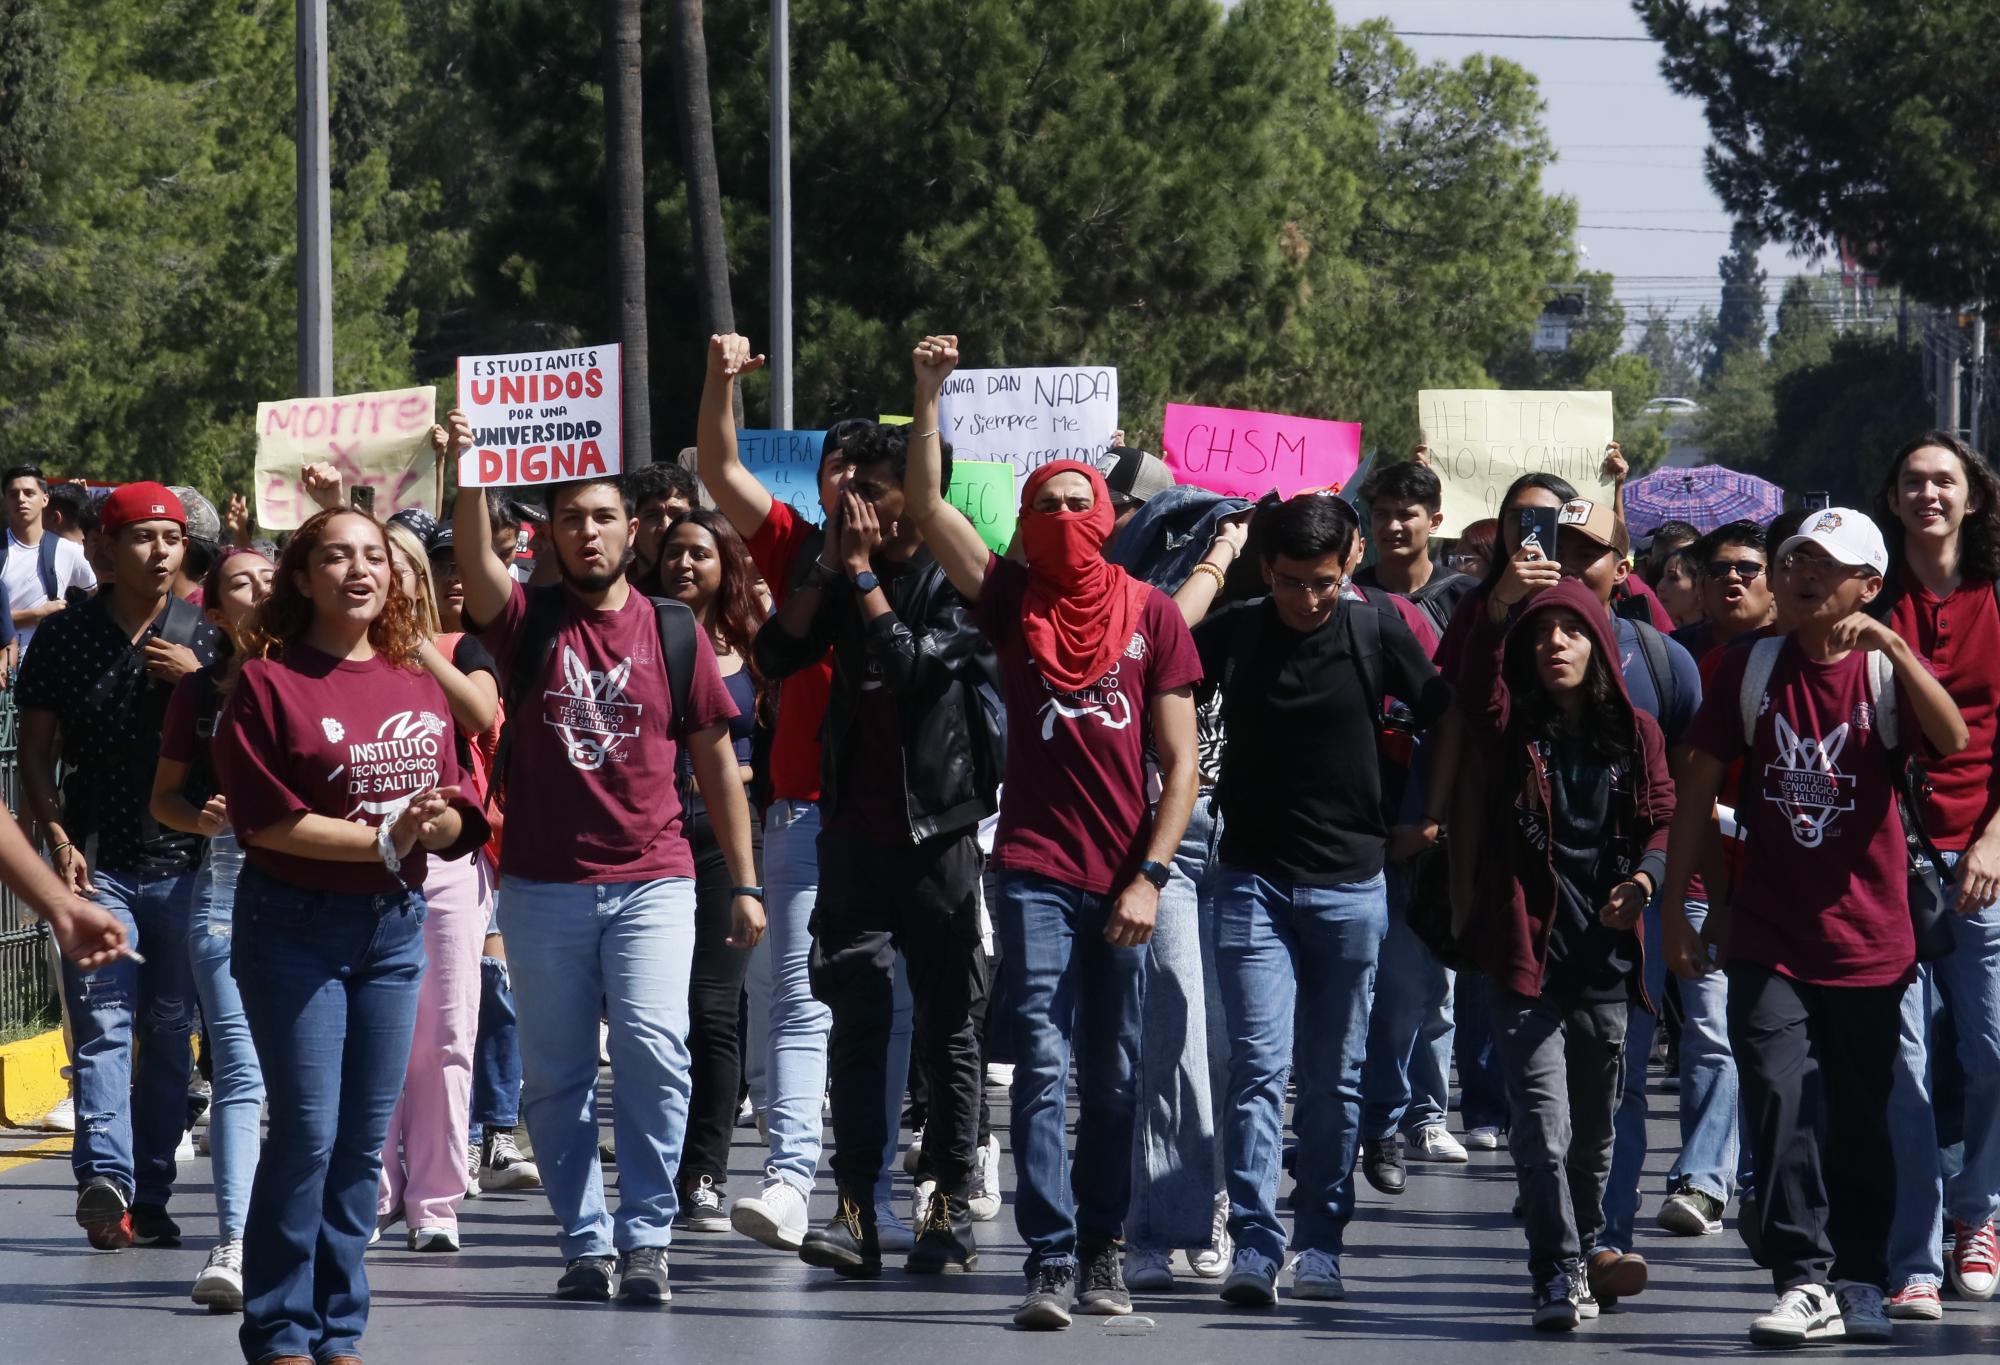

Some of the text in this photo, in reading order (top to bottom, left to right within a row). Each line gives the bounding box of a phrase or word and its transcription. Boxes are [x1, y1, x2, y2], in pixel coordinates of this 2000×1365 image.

[473, 350, 598, 376] ESTUDIANTES
[470, 367, 603, 405] UNIDOS
[987, 374, 1021, 395] DAN
[1034, 370, 1110, 407] NADA
[508, 405, 568, 421] POR UNA
[1512, 400, 1569, 443] TEC
[471, 420, 602, 448] UNIVERSIDAD
[478, 440, 607, 484] DIGNA
[737, 435, 813, 464] FUERA
[1184, 423, 1306, 476] CHSM
[1428, 444, 1476, 482] NO
[569, 698, 616, 714] INSTITUTO
[562, 715, 619, 732] DE SALTILLO
[349, 737, 438, 764] INSTITUTO
[351, 758, 437, 778] TECNOLÓGICO
[1783, 771, 1832, 786] INSTITUTO
[349, 772, 433, 795] DE SALTILLO
[1792, 792, 1835, 806] SALTILLO
